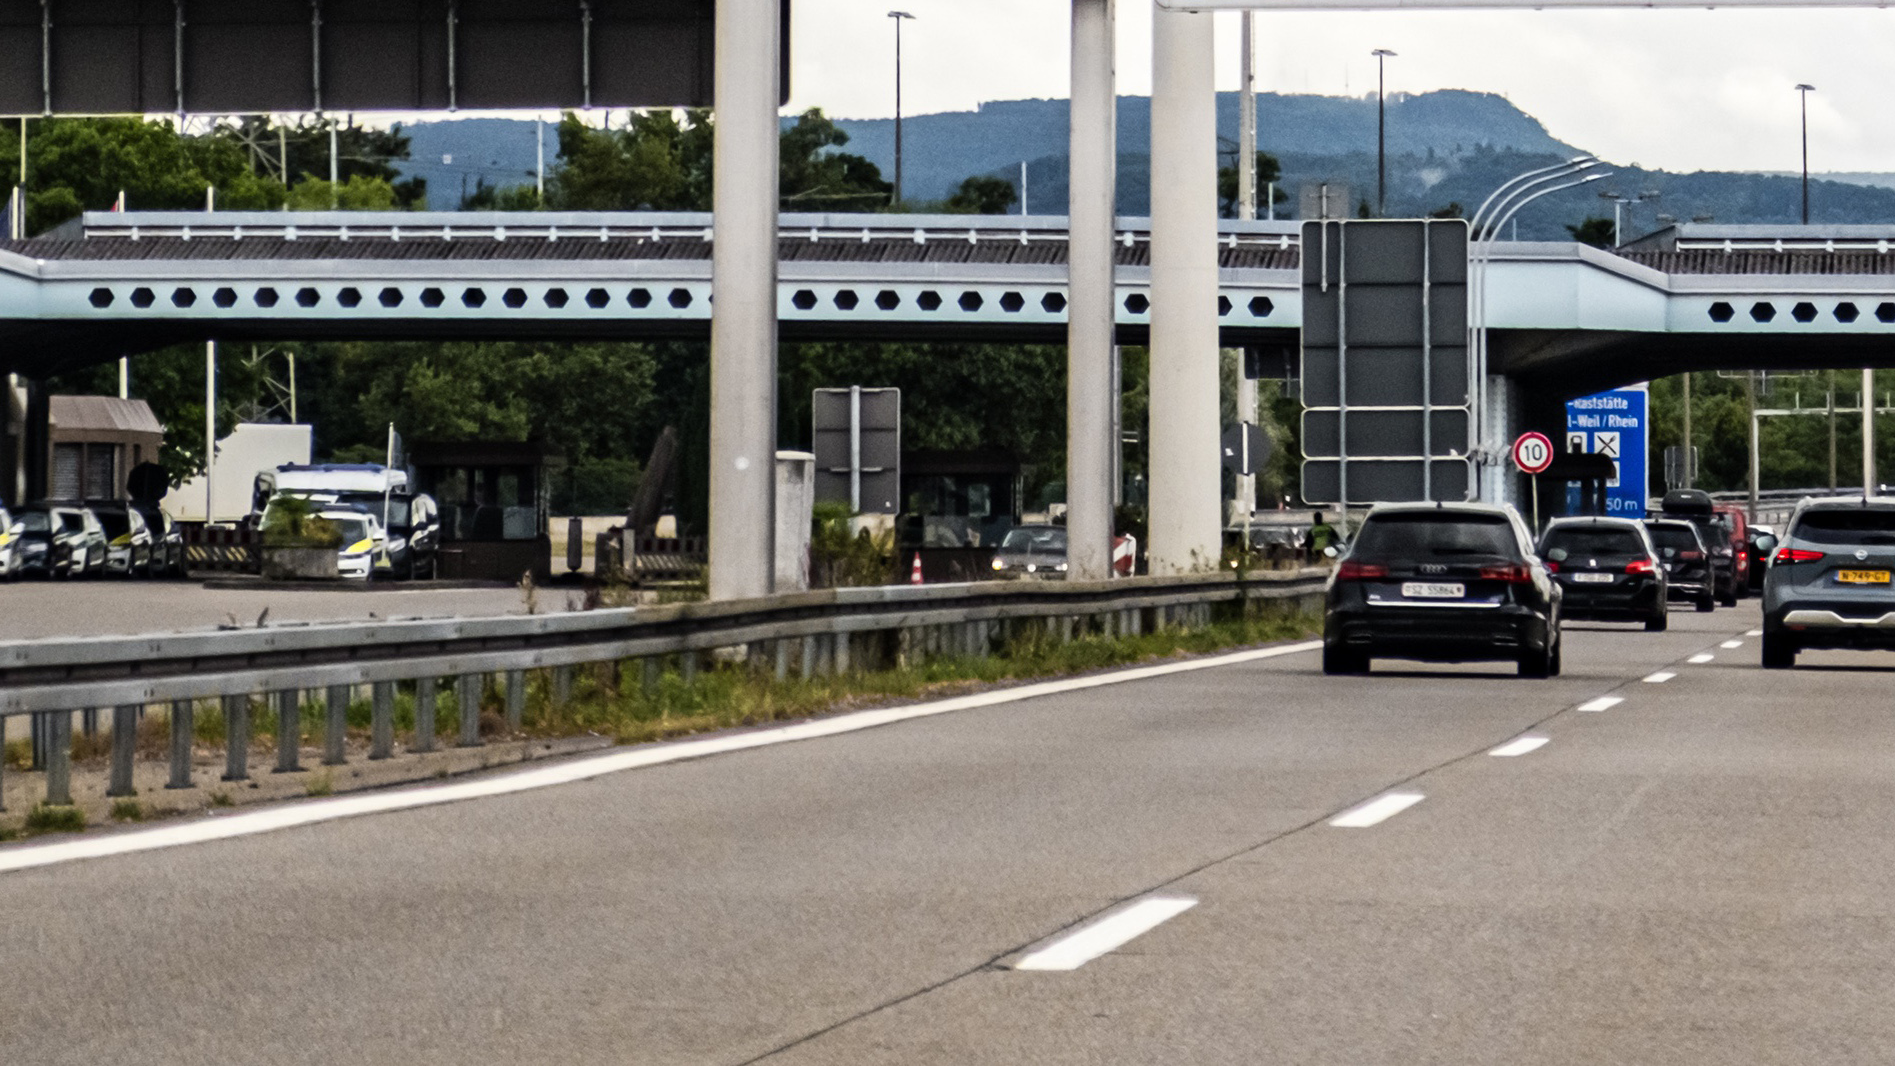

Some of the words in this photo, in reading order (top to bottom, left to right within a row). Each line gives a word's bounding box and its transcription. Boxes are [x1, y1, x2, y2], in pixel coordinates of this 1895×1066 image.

[1608, 414, 1639, 428] Rhein
[1524, 443, 1543, 461] 10
[1624, 499, 1638, 510] m
